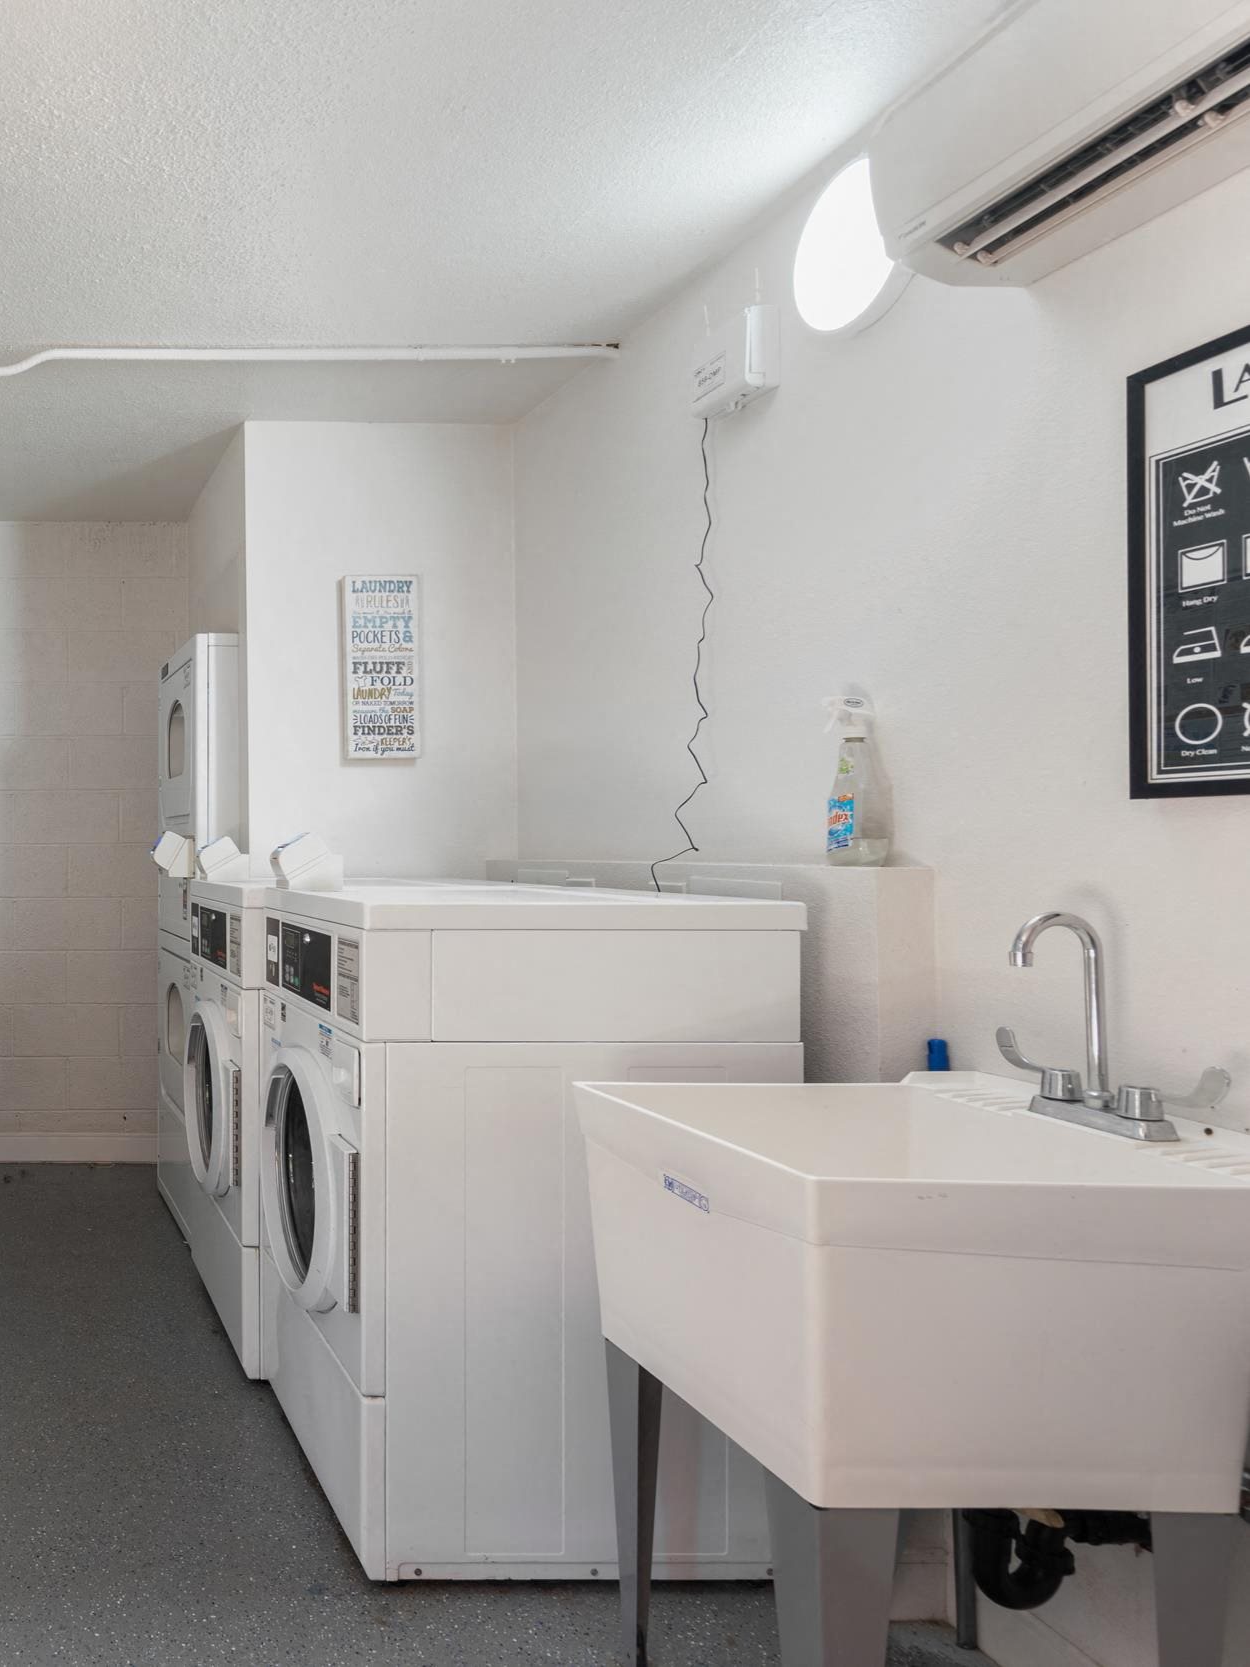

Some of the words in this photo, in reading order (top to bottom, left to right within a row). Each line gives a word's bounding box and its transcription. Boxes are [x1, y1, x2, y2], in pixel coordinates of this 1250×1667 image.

[1196, 504, 1211, 512] Not
[1173, 515, 1204, 527] Machine
[352, 580, 413, 593] LAUNDRY
[366, 595, 399, 608] RULES
[352, 616, 413, 629] EMPTY
[352, 630, 400, 644] POCKETS
[402, 630, 413, 643] &
[352, 644, 387, 655] Separate
[388, 643, 414, 653] Colors
[352, 662, 405, 674] FLUFF
[370, 676, 414, 686] FOLD
[352, 687, 392, 700] LAUNDRY
[360, 714, 382, 724] LOADS
[384, 714, 393, 724] OF
[394, 714, 408, 724] FUN
[353, 725, 414, 735] FINDER'S
[381, 736, 412, 746] KEEPER'S
[354, 743, 371, 752] Iron
[373, 742, 380, 754] if
[380, 746, 394, 756] you
[396, 743, 414, 752] must
